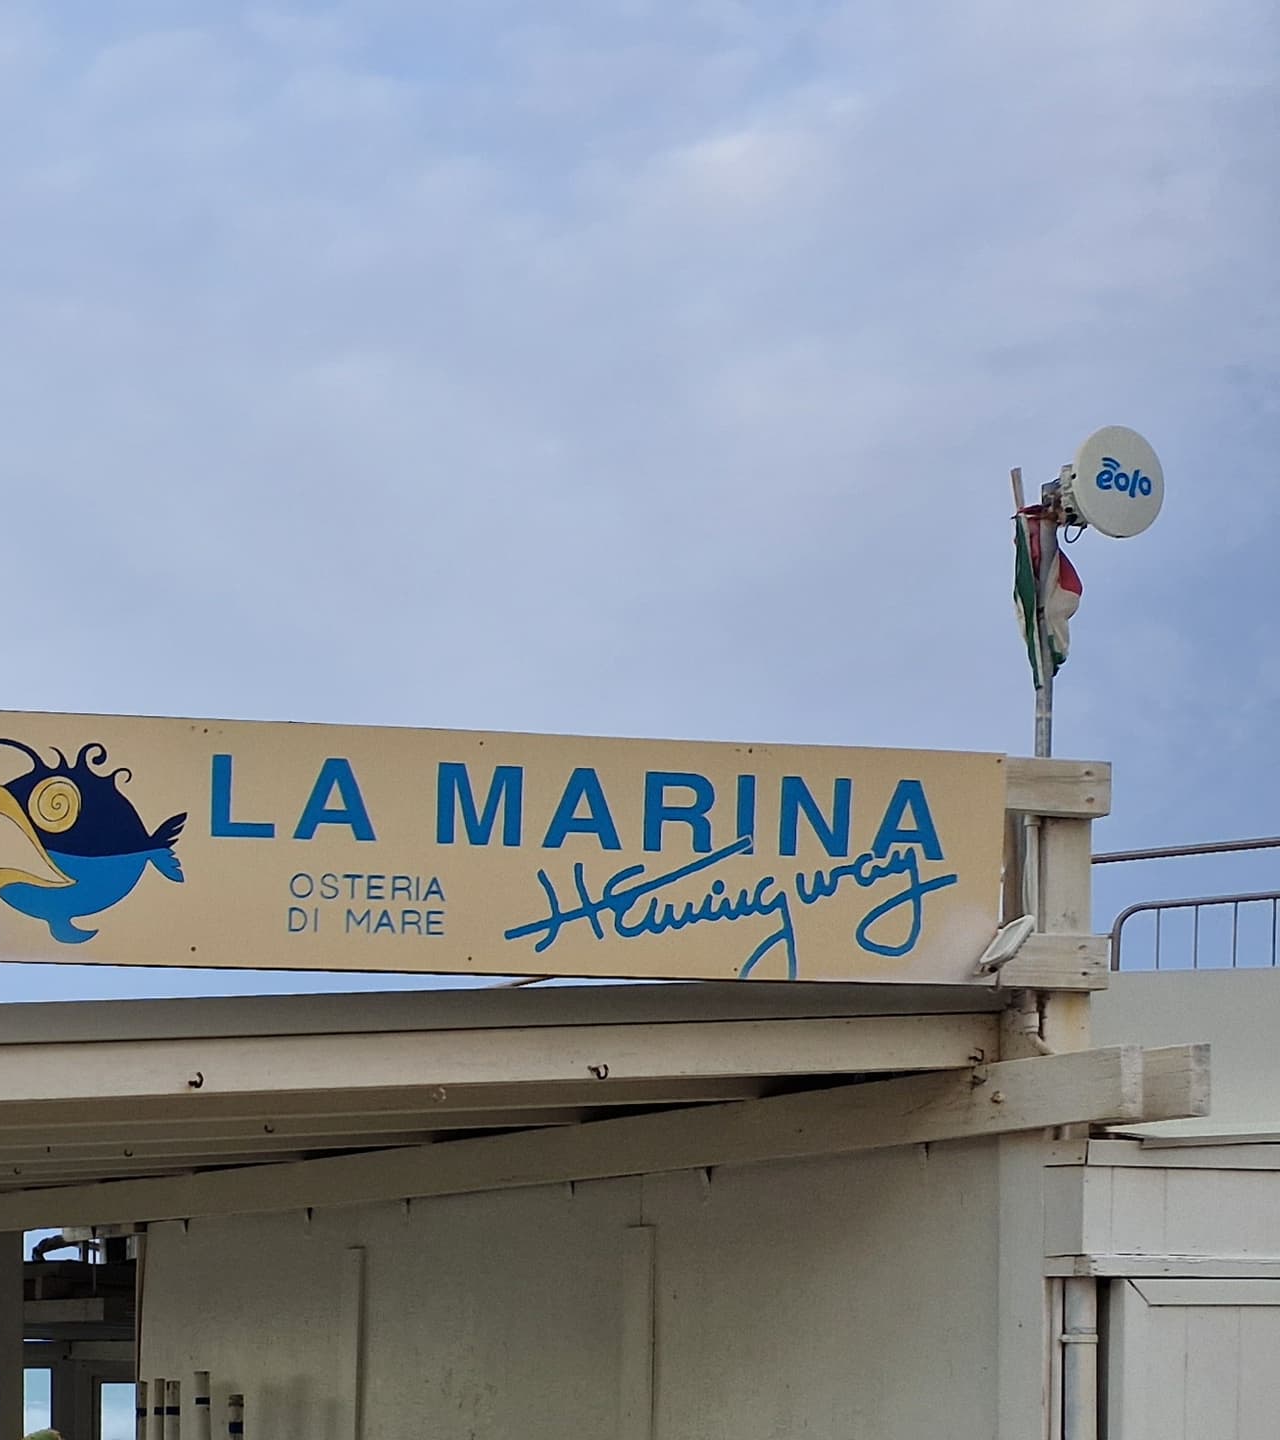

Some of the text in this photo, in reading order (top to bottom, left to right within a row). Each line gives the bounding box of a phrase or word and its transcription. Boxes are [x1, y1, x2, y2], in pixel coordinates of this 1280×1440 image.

[1096, 466, 1152, 498] eolo
[210, 754, 945, 861] LA MARINA
[289, 872, 446, 902] OSTERIA
[288, 906, 446, 936] DI MARE
[504, 835, 958, 979] Hemingway
